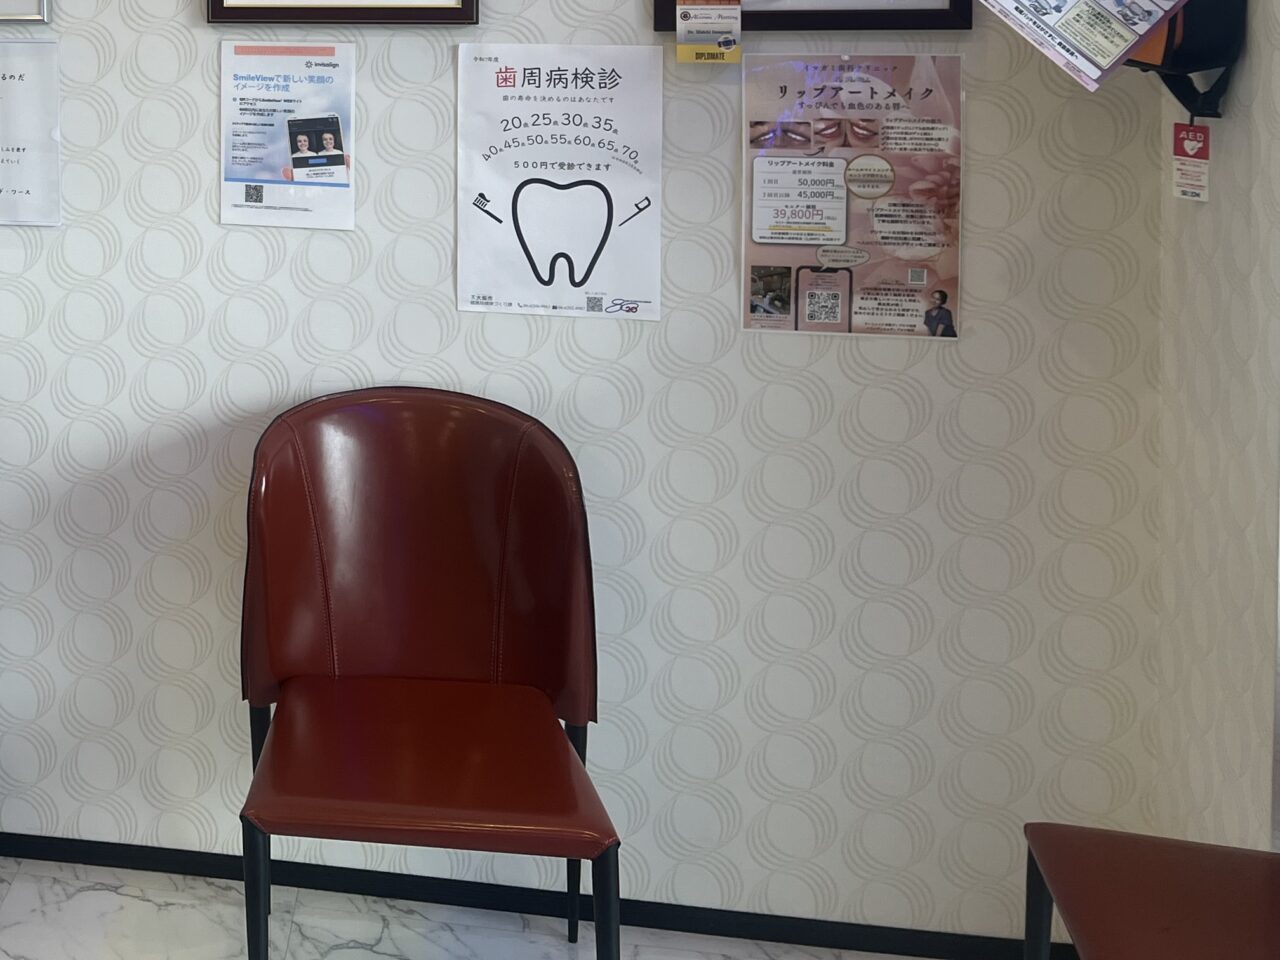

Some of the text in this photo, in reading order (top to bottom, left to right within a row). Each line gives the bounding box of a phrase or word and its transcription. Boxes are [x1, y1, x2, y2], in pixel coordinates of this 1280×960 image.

[695, 52, 725, 61] DIPLOMATE
[495, 65, 623, 90] 歯周病検診
[233, 83, 291, 93] イメージを作成
[778, 85, 935, 101] リップアートメイク
[1179, 130, 1204, 141] AED
[797, 178, 835, 188] 50,000円
[797, 190, 835, 199] 45,000円
[773, 208, 824, 221] 39,800円
